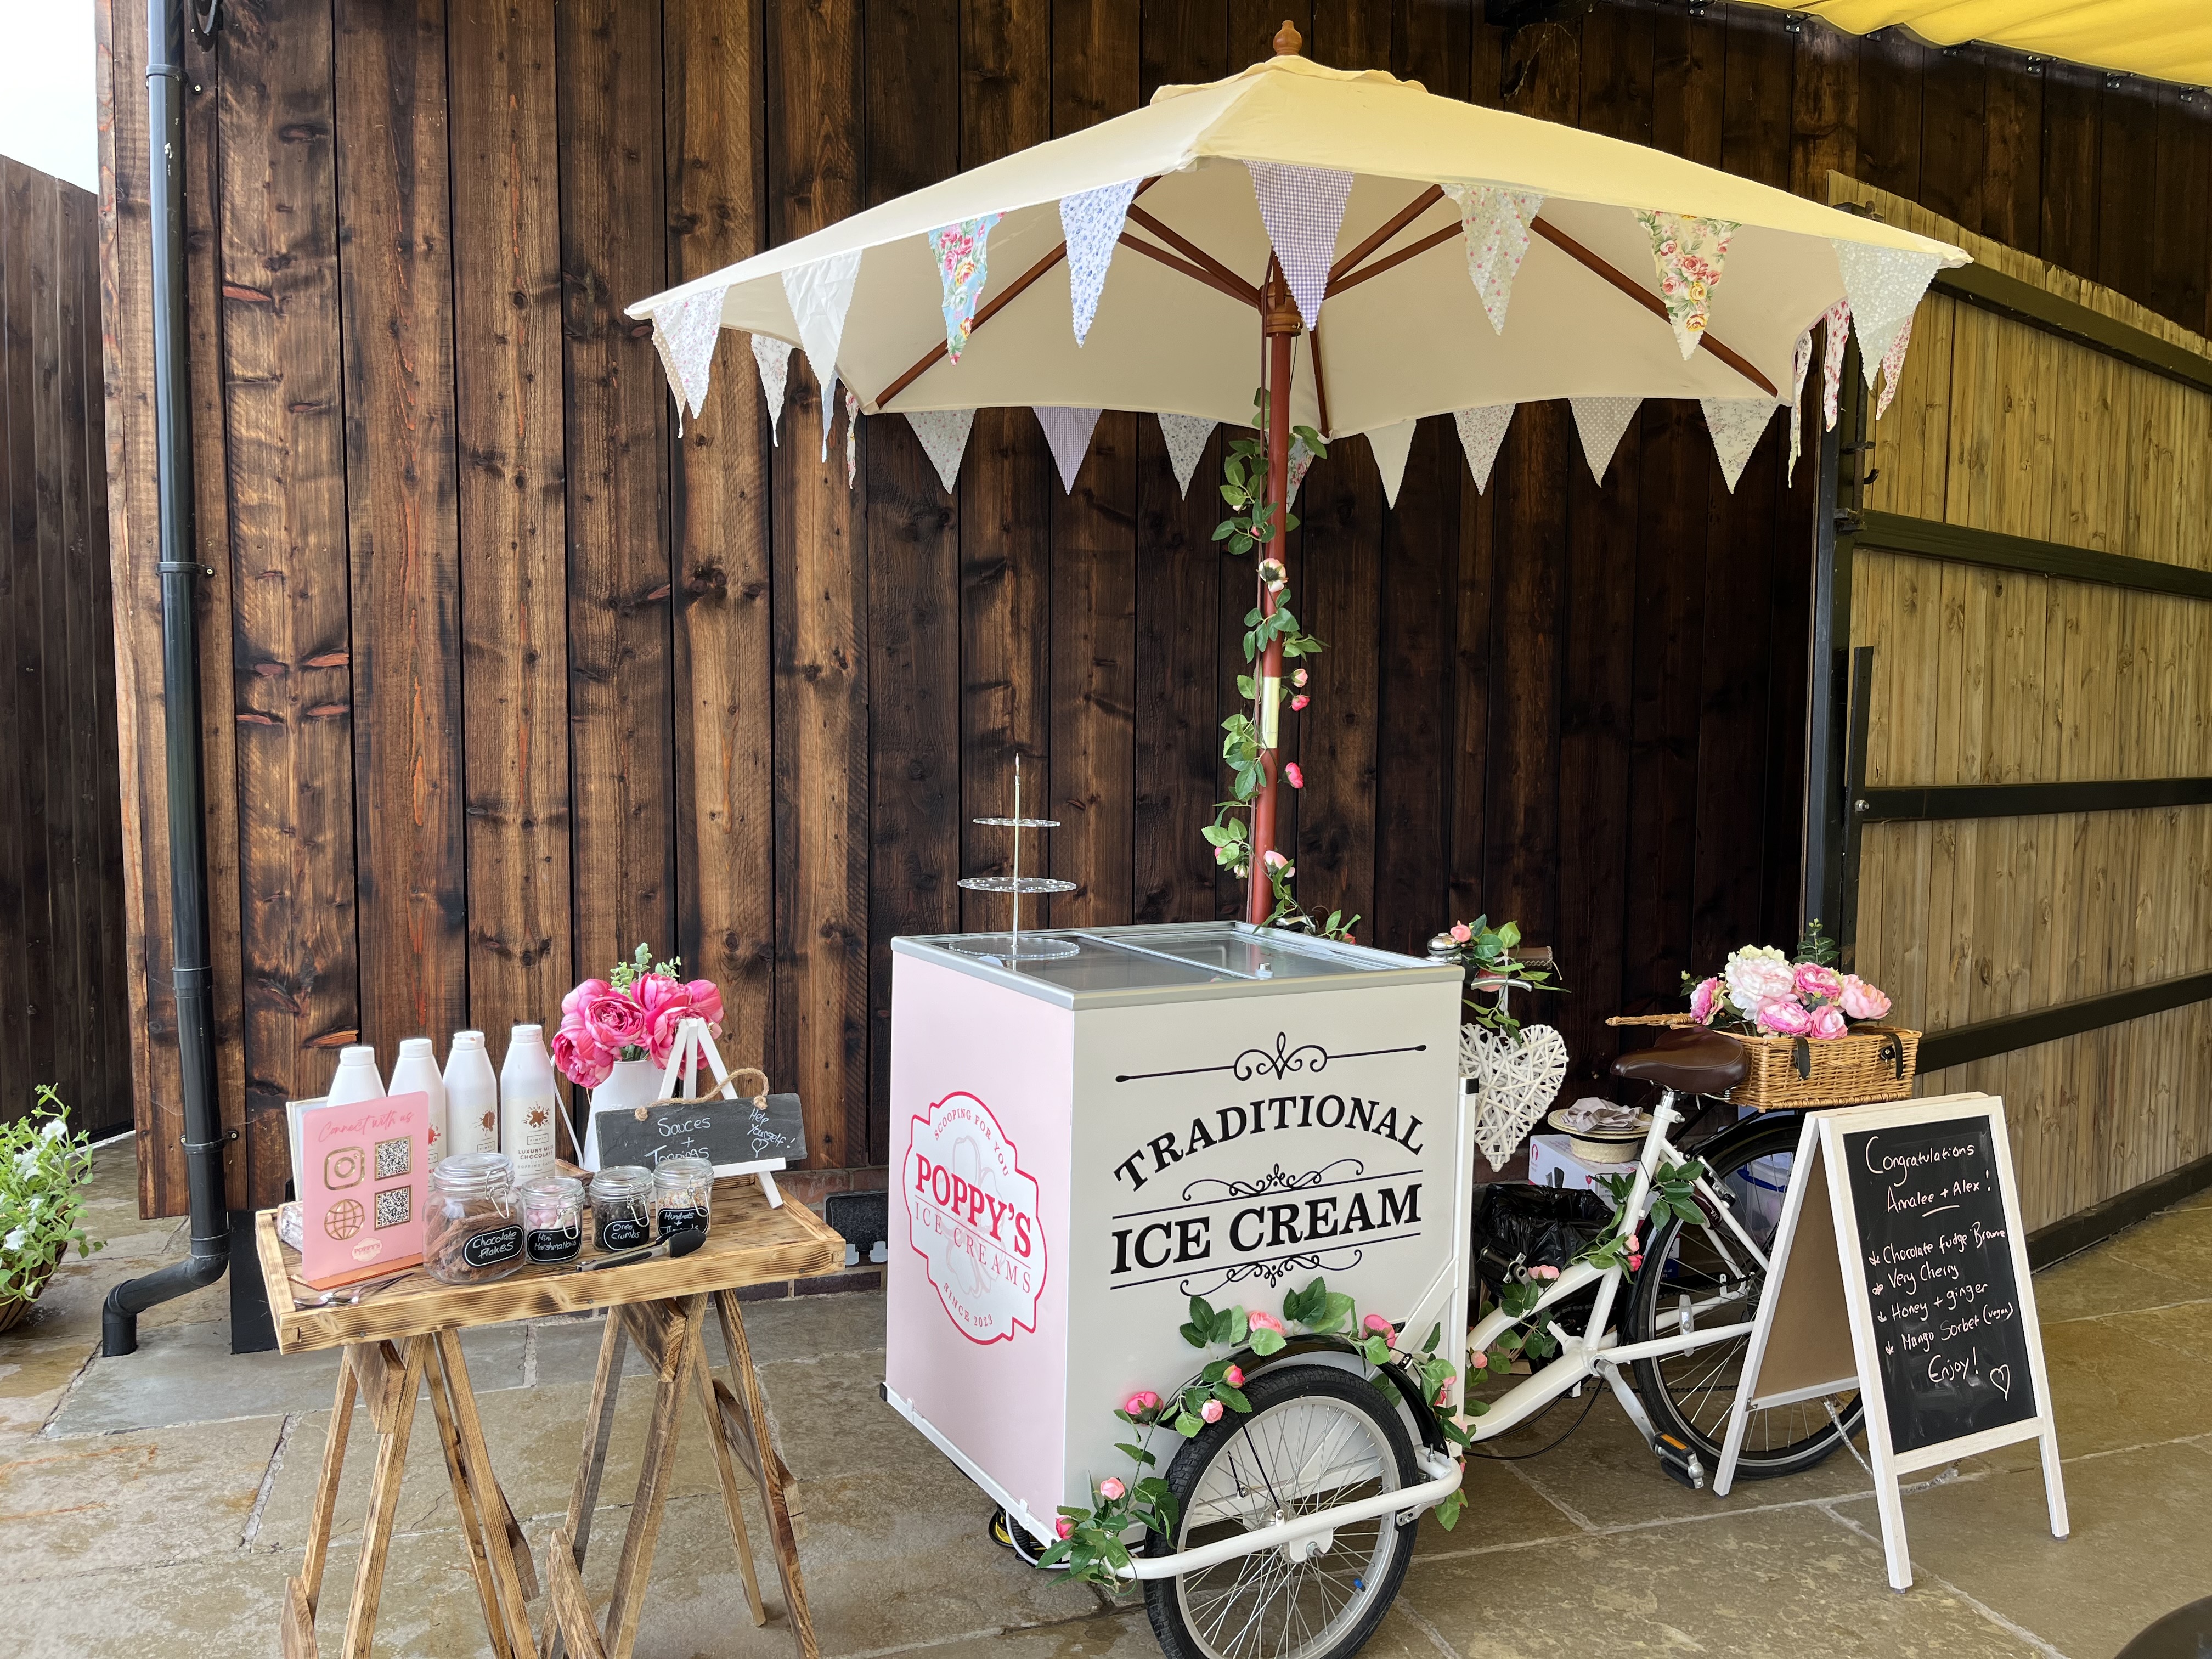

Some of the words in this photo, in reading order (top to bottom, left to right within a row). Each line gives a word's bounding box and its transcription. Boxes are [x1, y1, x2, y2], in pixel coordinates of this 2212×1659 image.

[318, 1114, 374, 1143] Connect
[372, 1110, 397, 1130] with
[400, 1111, 414, 1123] us
[657, 1117, 711, 1137] Sauces
[748, 1108, 769, 1124] Help
[520, 1150, 553, 1160] CHOCOLATE
[934, 1108, 972, 1141] SCOOPING
[974, 1118, 991, 1141] FOR
[994, 1141, 1008, 1177] YOU
[1113, 1094, 1424, 1192] TRADITIONAL
[1865, 1136, 1975, 1187] Congratulations
[915, 1152, 1031, 1259] POPPY'S
[472, 1230, 517, 1249] Chocolate
[537, 1233, 552, 1242] Mini
[611, 1231, 640, 1239] Crumbs
[1110, 1216, 1210, 1275] ICE
[1229, 1183, 1423, 1252] CREAM
[915, 1201, 943, 1235] ICE
[953, 1228, 1031, 1294] CREAMS
[1883, 1243, 1933, 1264] Chocolate
[1888, 1268, 1917, 1295] Very
[1920, 1261, 1959, 1280] Cherry
[944, 1282, 970, 1322] SINCE
[974, 1314, 993, 1328] 2023
[1892, 1302, 1928, 1321] Honey
[1947, 1283, 1988, 1310] ginger
[1901, 1333, 1934, 1352] Mango
[1940, 1314, 1980, 1340] Sorbet
[1983, 1302, 2014, 1325] (vegan)
